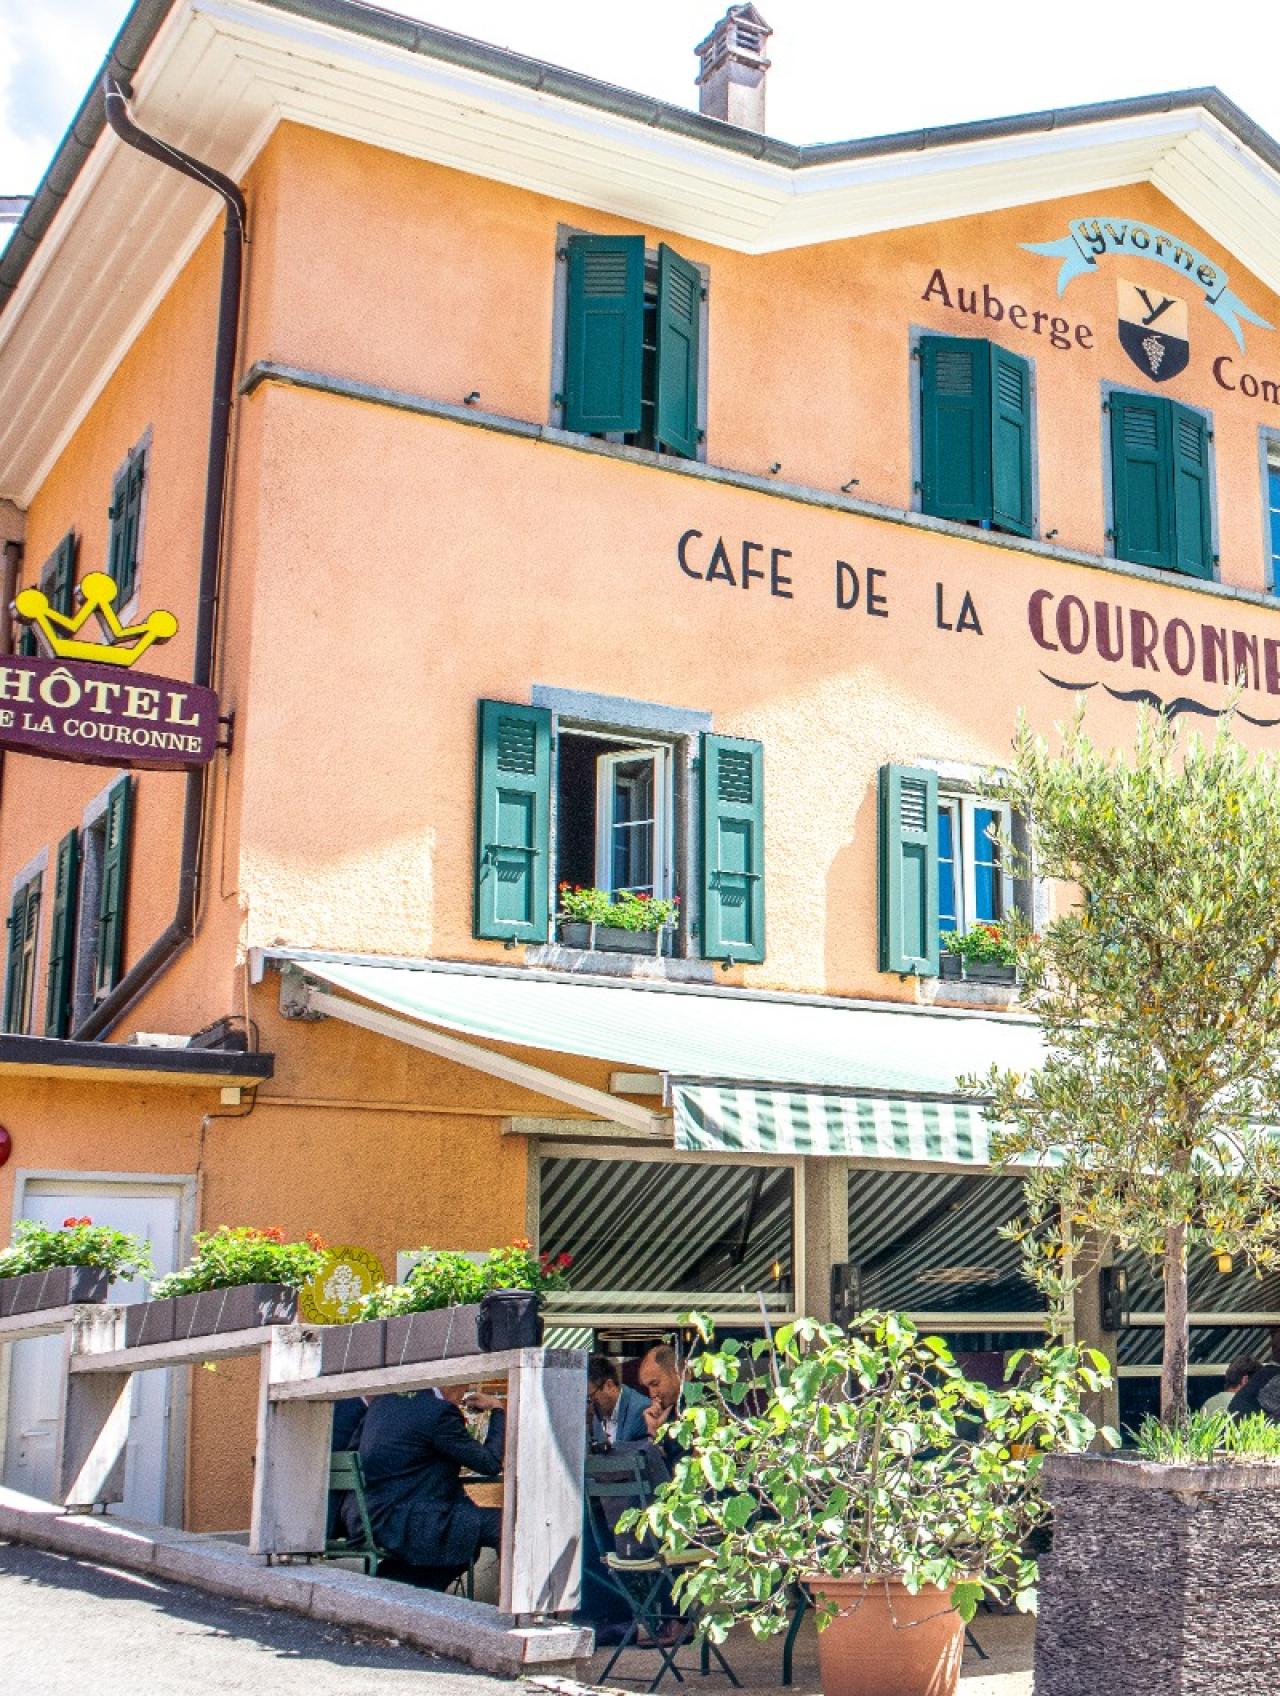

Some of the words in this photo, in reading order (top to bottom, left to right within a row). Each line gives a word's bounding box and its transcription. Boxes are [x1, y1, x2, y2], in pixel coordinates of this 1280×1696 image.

[921, 268, 1094, 350] Auberge
[678, 529, 793, 599] CAFE
[836, 560, 889, 618] DE
[936, 582, 984, 636] LA
[0, 667, 200, 727] HÔTEL
[0, 709, 14, 728] E
[23, 713, 55, 734] LA
[63, 719, 202, 753] COURONNE
